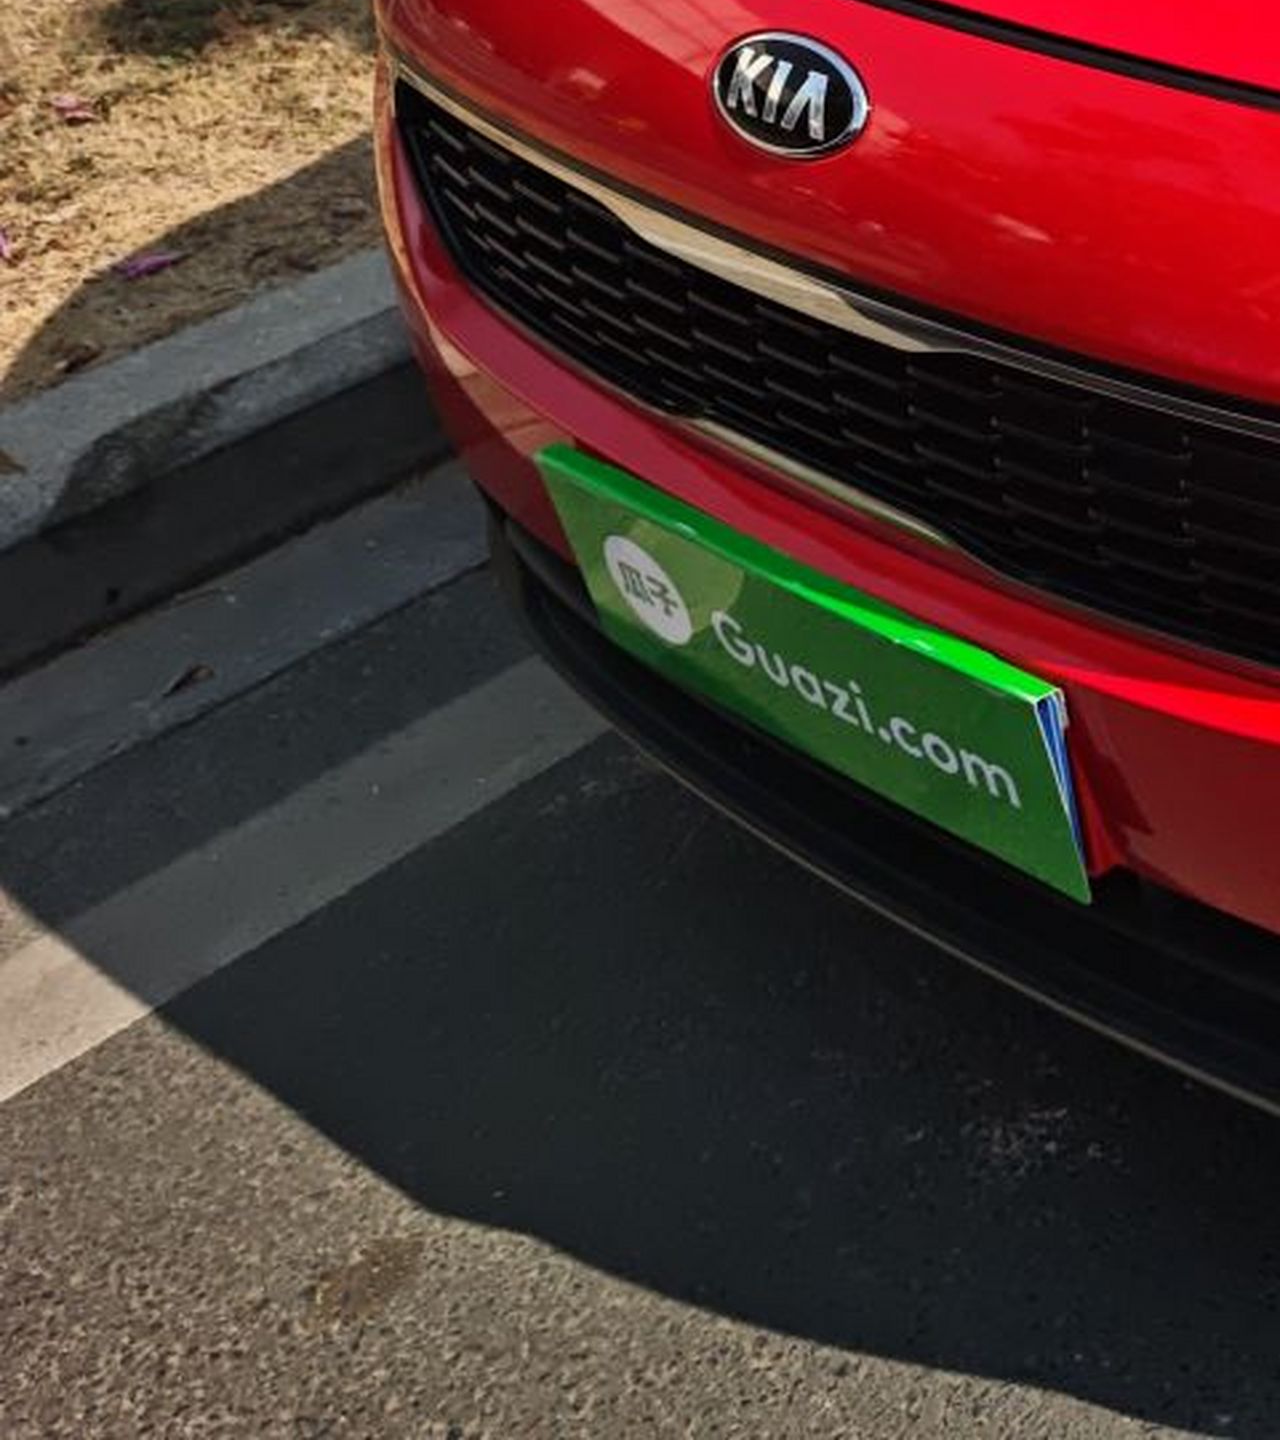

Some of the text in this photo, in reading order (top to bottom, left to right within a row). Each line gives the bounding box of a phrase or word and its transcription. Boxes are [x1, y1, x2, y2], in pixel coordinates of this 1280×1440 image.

[727, 46, 829, 141] KIA
[616, 560, 679, 618] 瓜子
[711, 610, 1021, 809] Guazi.com
